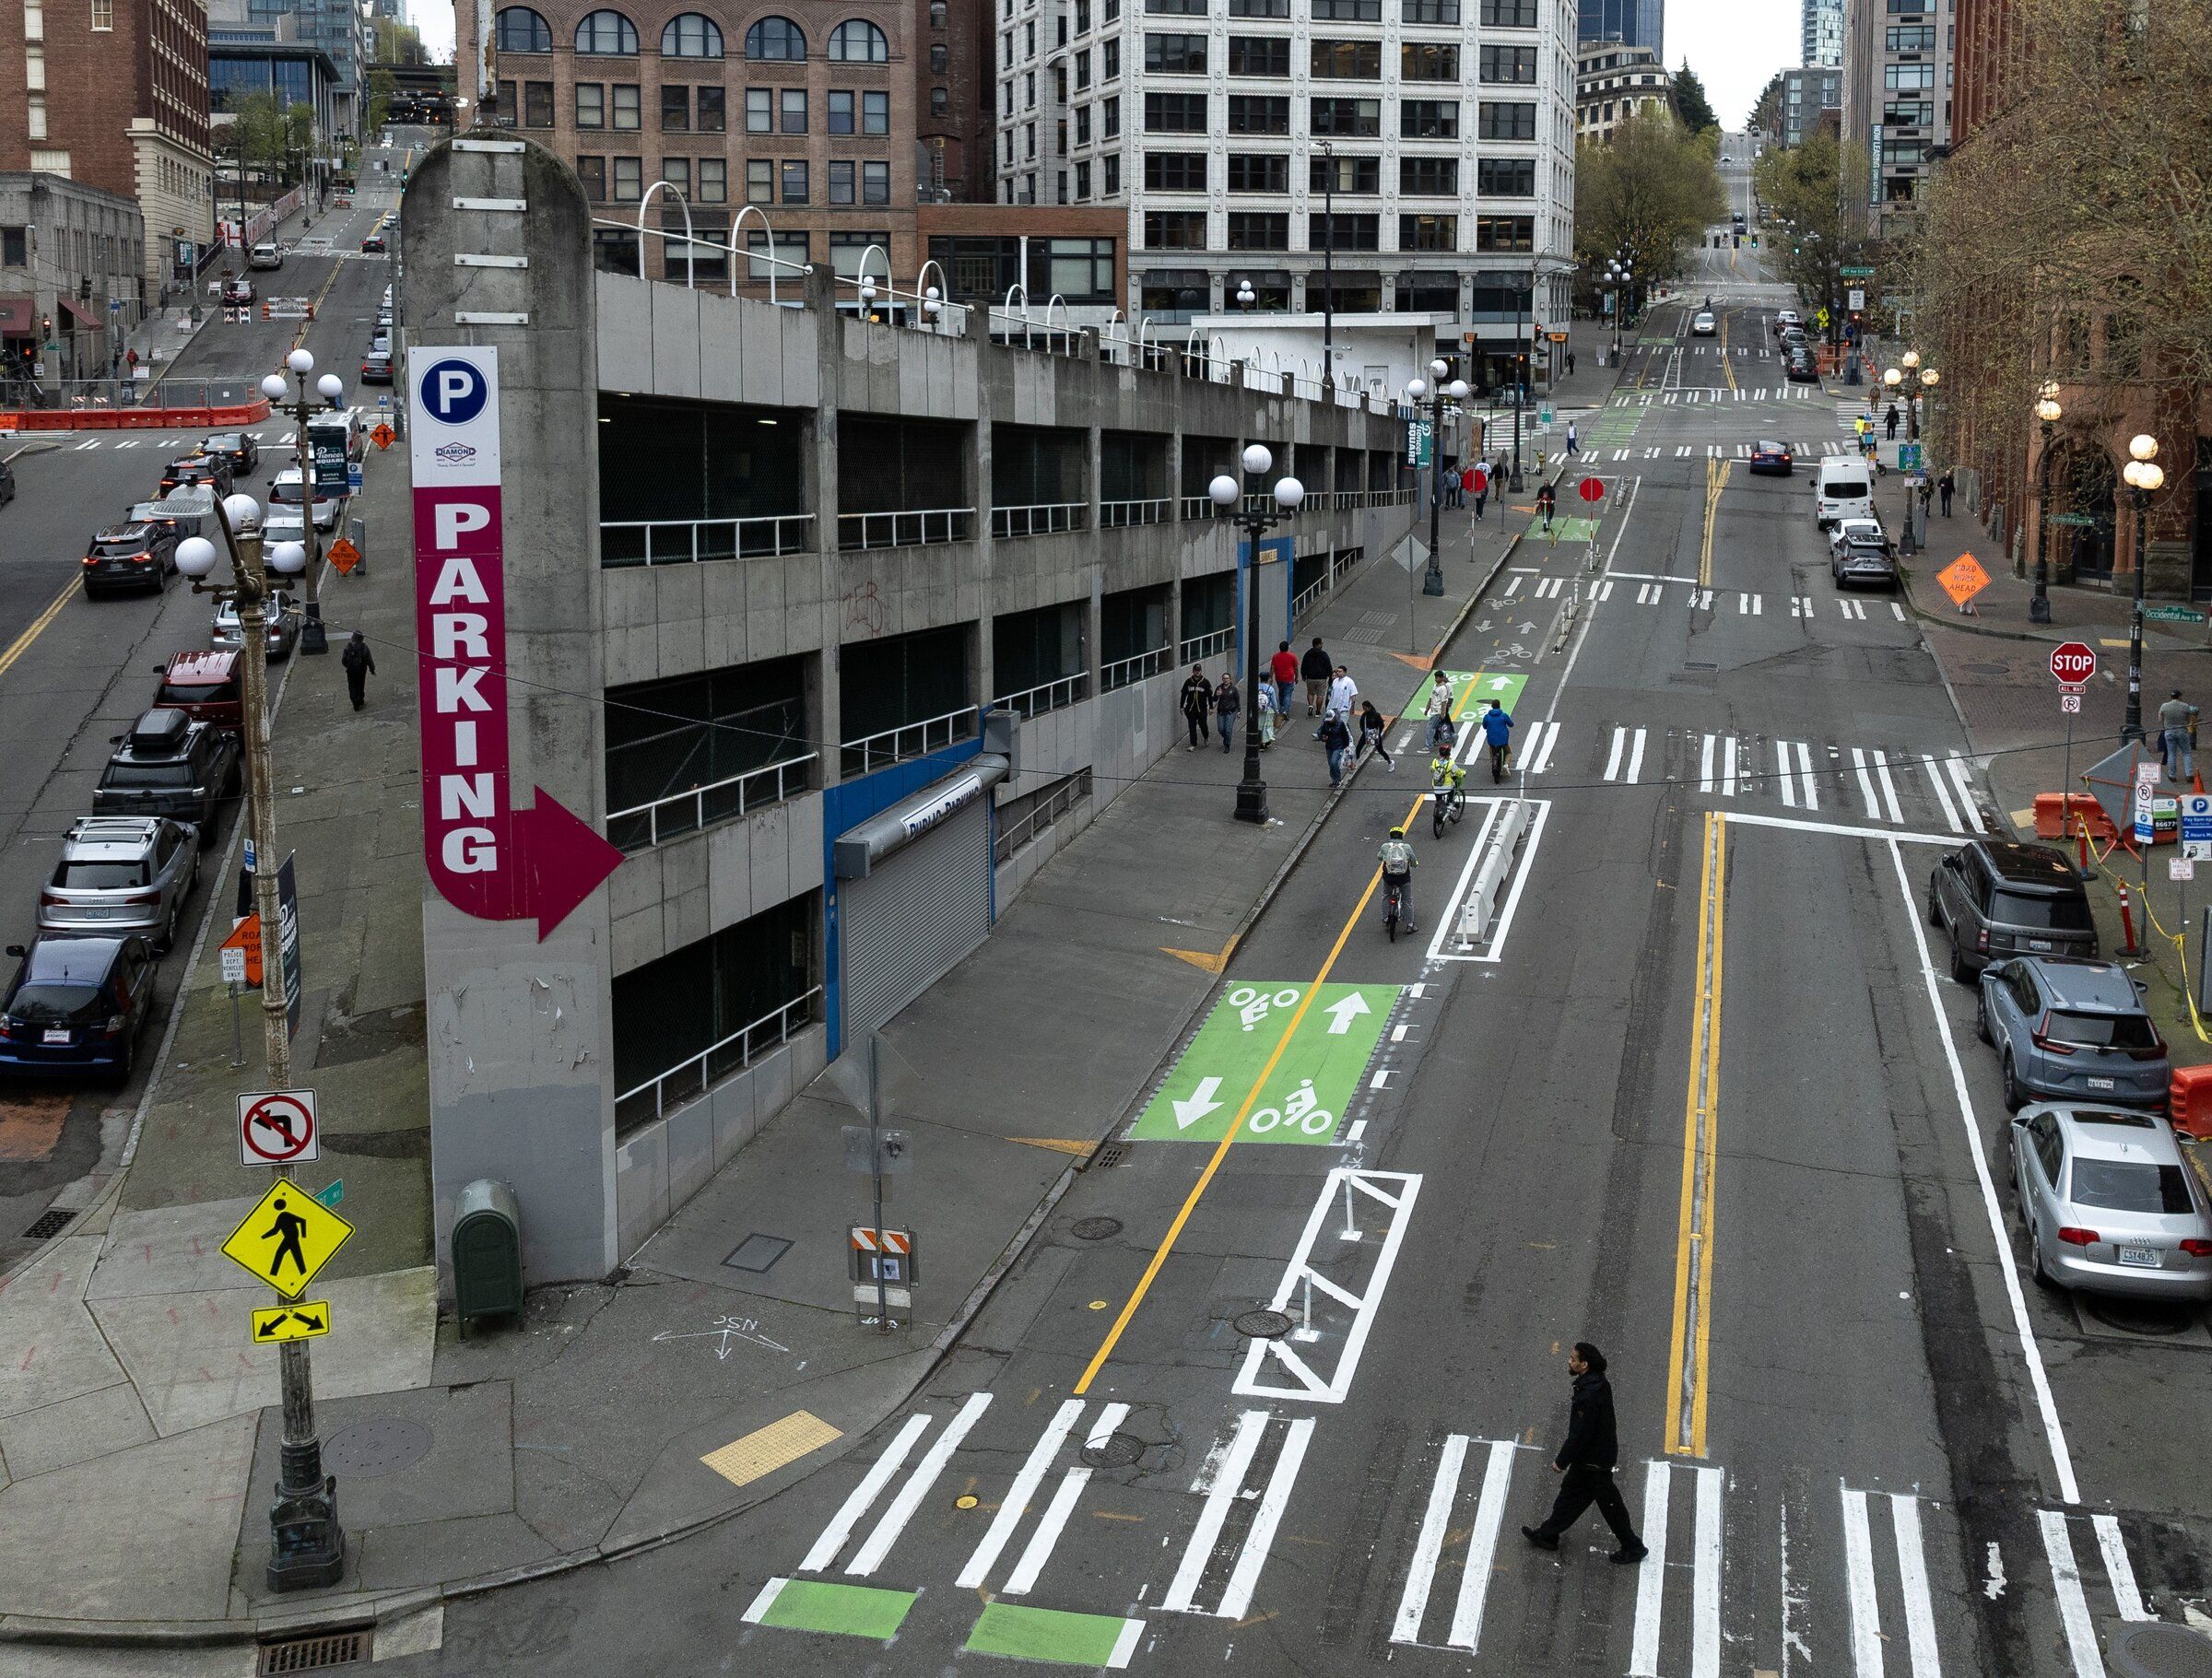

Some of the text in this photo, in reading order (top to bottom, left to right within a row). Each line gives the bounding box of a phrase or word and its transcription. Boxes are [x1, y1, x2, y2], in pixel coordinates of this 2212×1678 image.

[1873, 141, 1881, 169] LEASING
[1306, 259, 1338, 268] SMIH
[439, 370, 474, 414] P
[1408, 422, 1417, 464] SQUARE
[1416, 423, 1431, 455] Pioneer
[316, 446, 344, 459] Pioneer
[435, 447, 477, 456] DIAMOND
[1948, 583, 1977, 592] AHEAD
[2145, 609, 2180, 620] Occidental
[2053, 655, 2092, 671] STOP
[429, 503, 499, 874] PARKING
[2196, 801, 2206, 811] P
[241, 931, 262, 940] ROA
[242, 943, 262, 952] WOR
